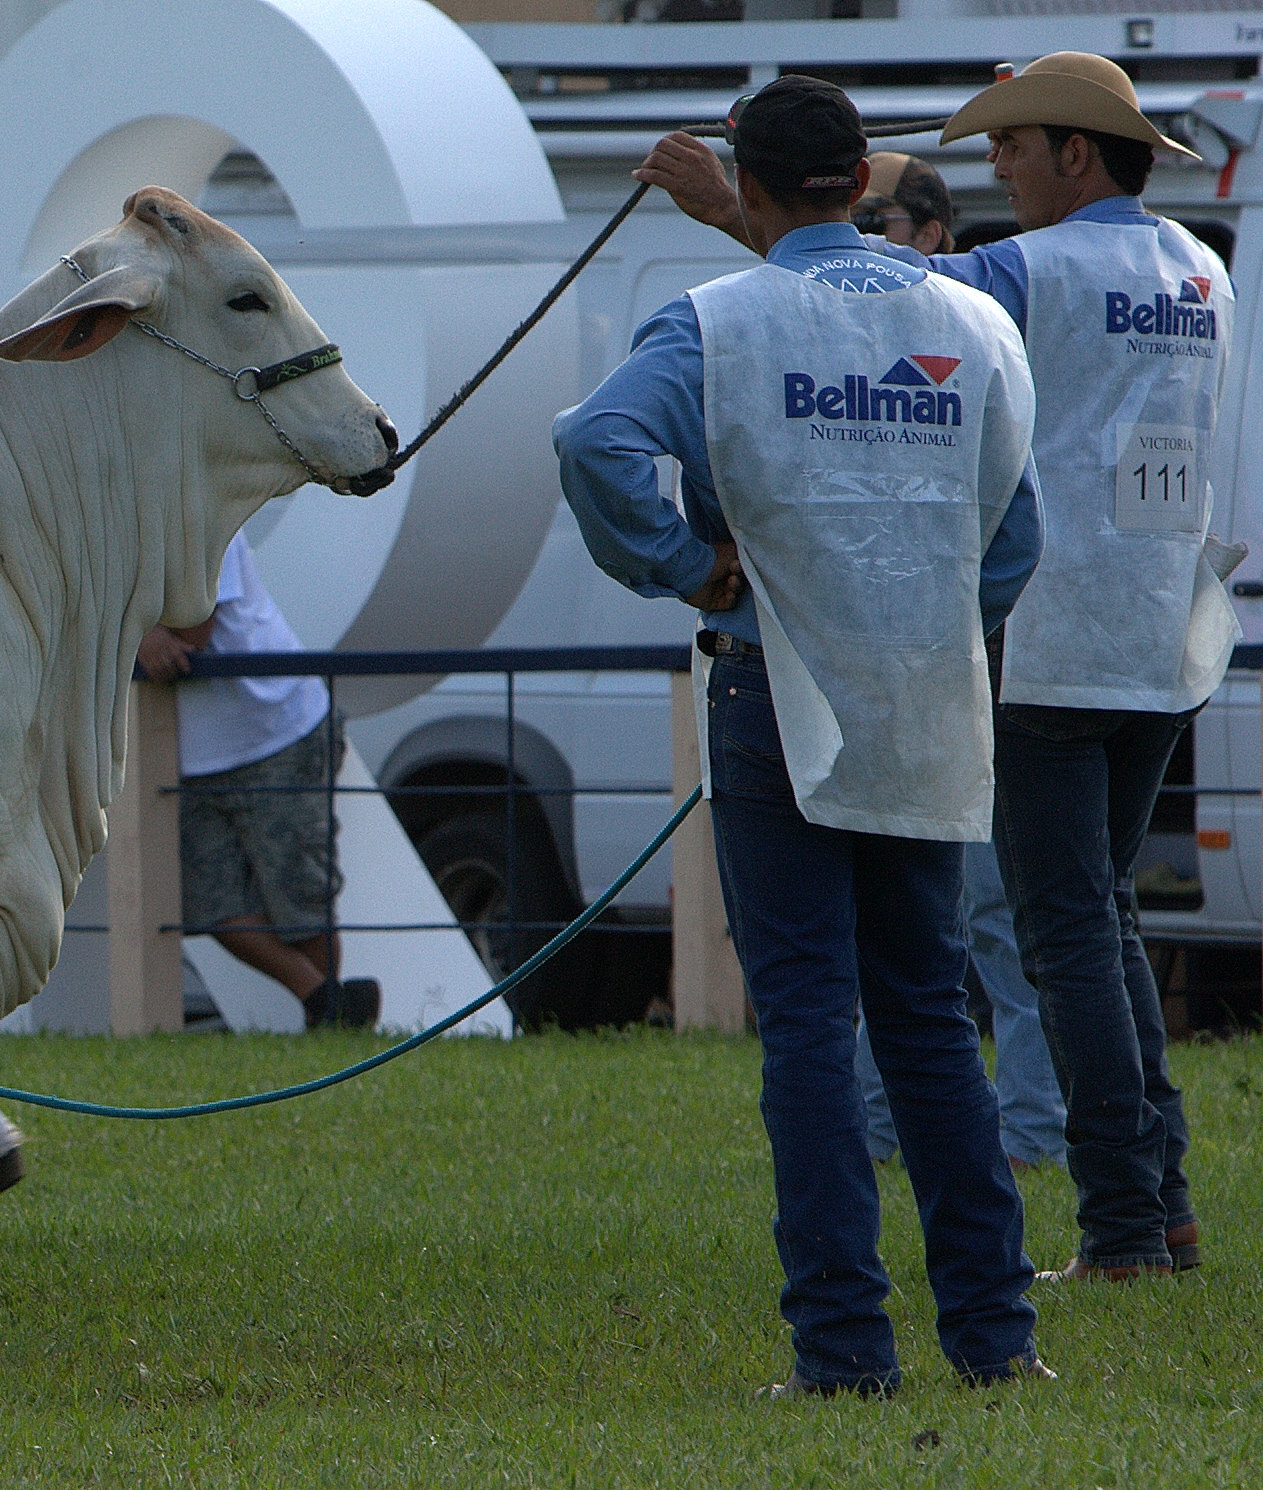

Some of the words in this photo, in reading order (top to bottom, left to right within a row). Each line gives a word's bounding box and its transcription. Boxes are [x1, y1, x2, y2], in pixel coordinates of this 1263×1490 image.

[822, 259, 863, 270] NOVA
[1106, 292, 1216, 340] Bellman
[784, 373, 962, 426] Bellman
[898, 427, 956, 447] ANIMAL
[1139, 436, 1193, 452] VICTORIA
[1133, 462, 1187, 502] 111
